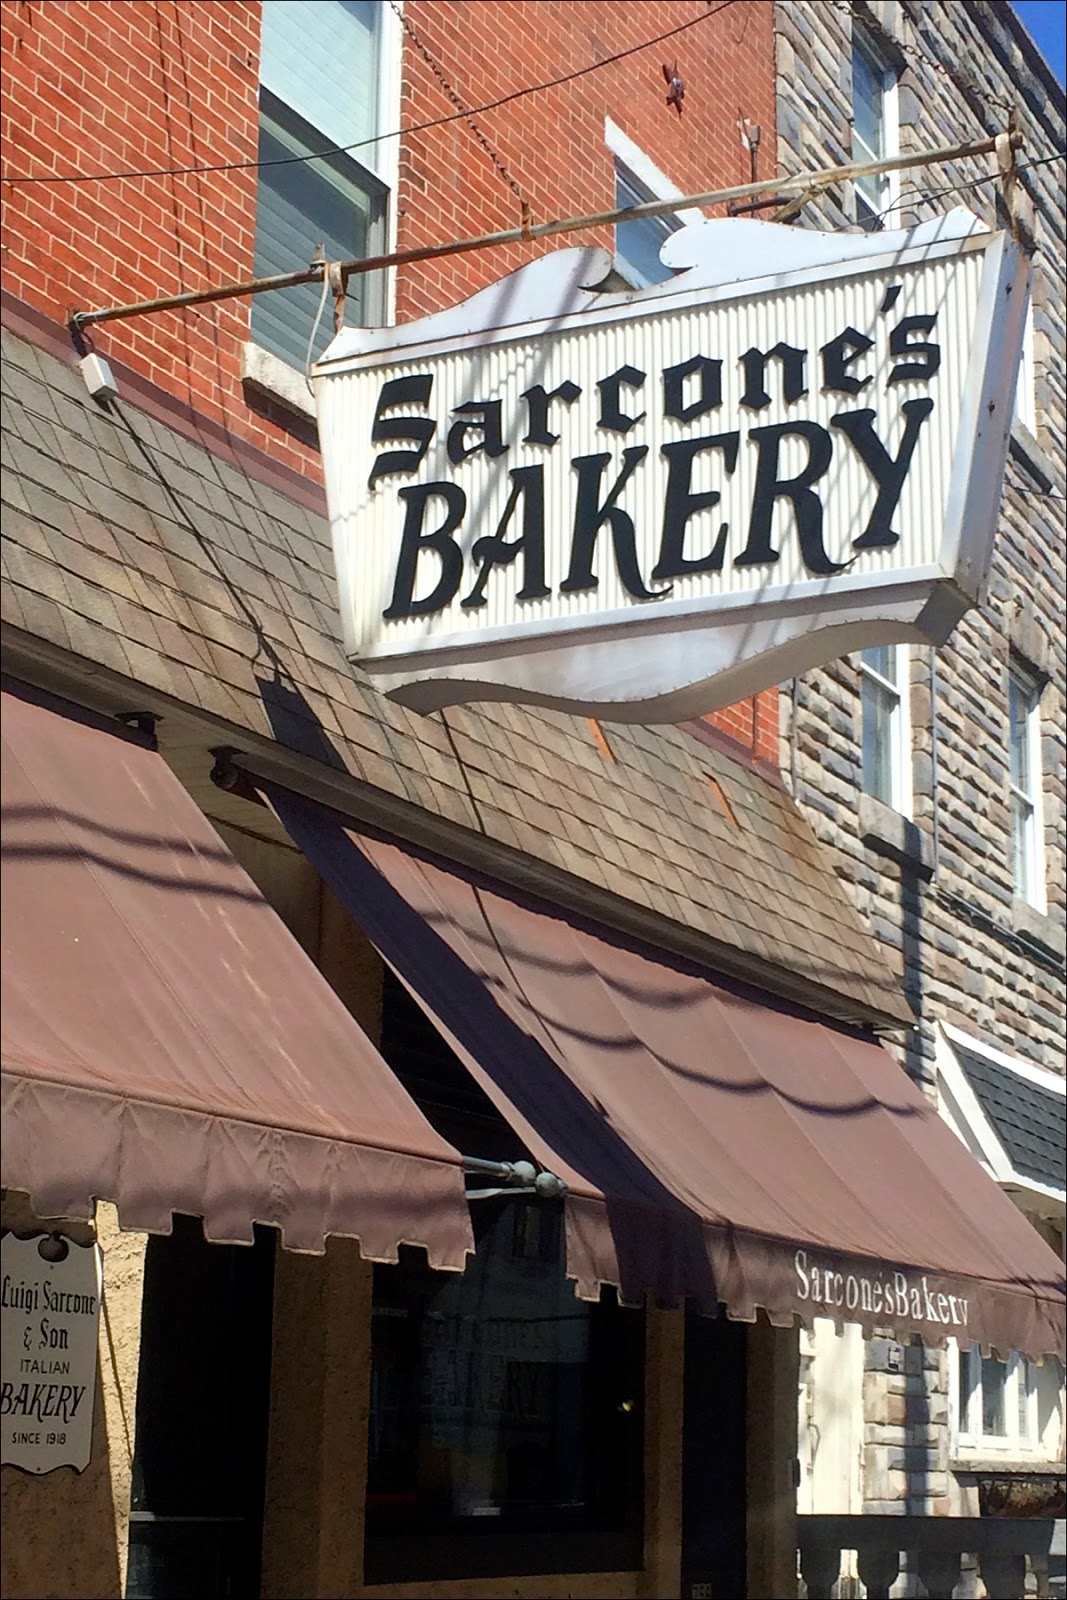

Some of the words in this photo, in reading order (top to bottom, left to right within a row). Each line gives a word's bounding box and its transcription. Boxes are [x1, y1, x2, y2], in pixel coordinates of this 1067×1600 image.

[368, 284, 943, 492] Sarcone's
[382, 398, 935, 621] BAKERY
[1, 1275, 39, 1315] Luigi
[42, 1280, 96, 1315] Sarcone
[38, 1317, 68, 1350] Son
[20, 1359, 70, 1374] ITALIAN
[0, 1382, 86, 1424] BAKERY
[11, 1432, 40, 1444] SINCE
[46, 1432, 67, 1445] 1918
